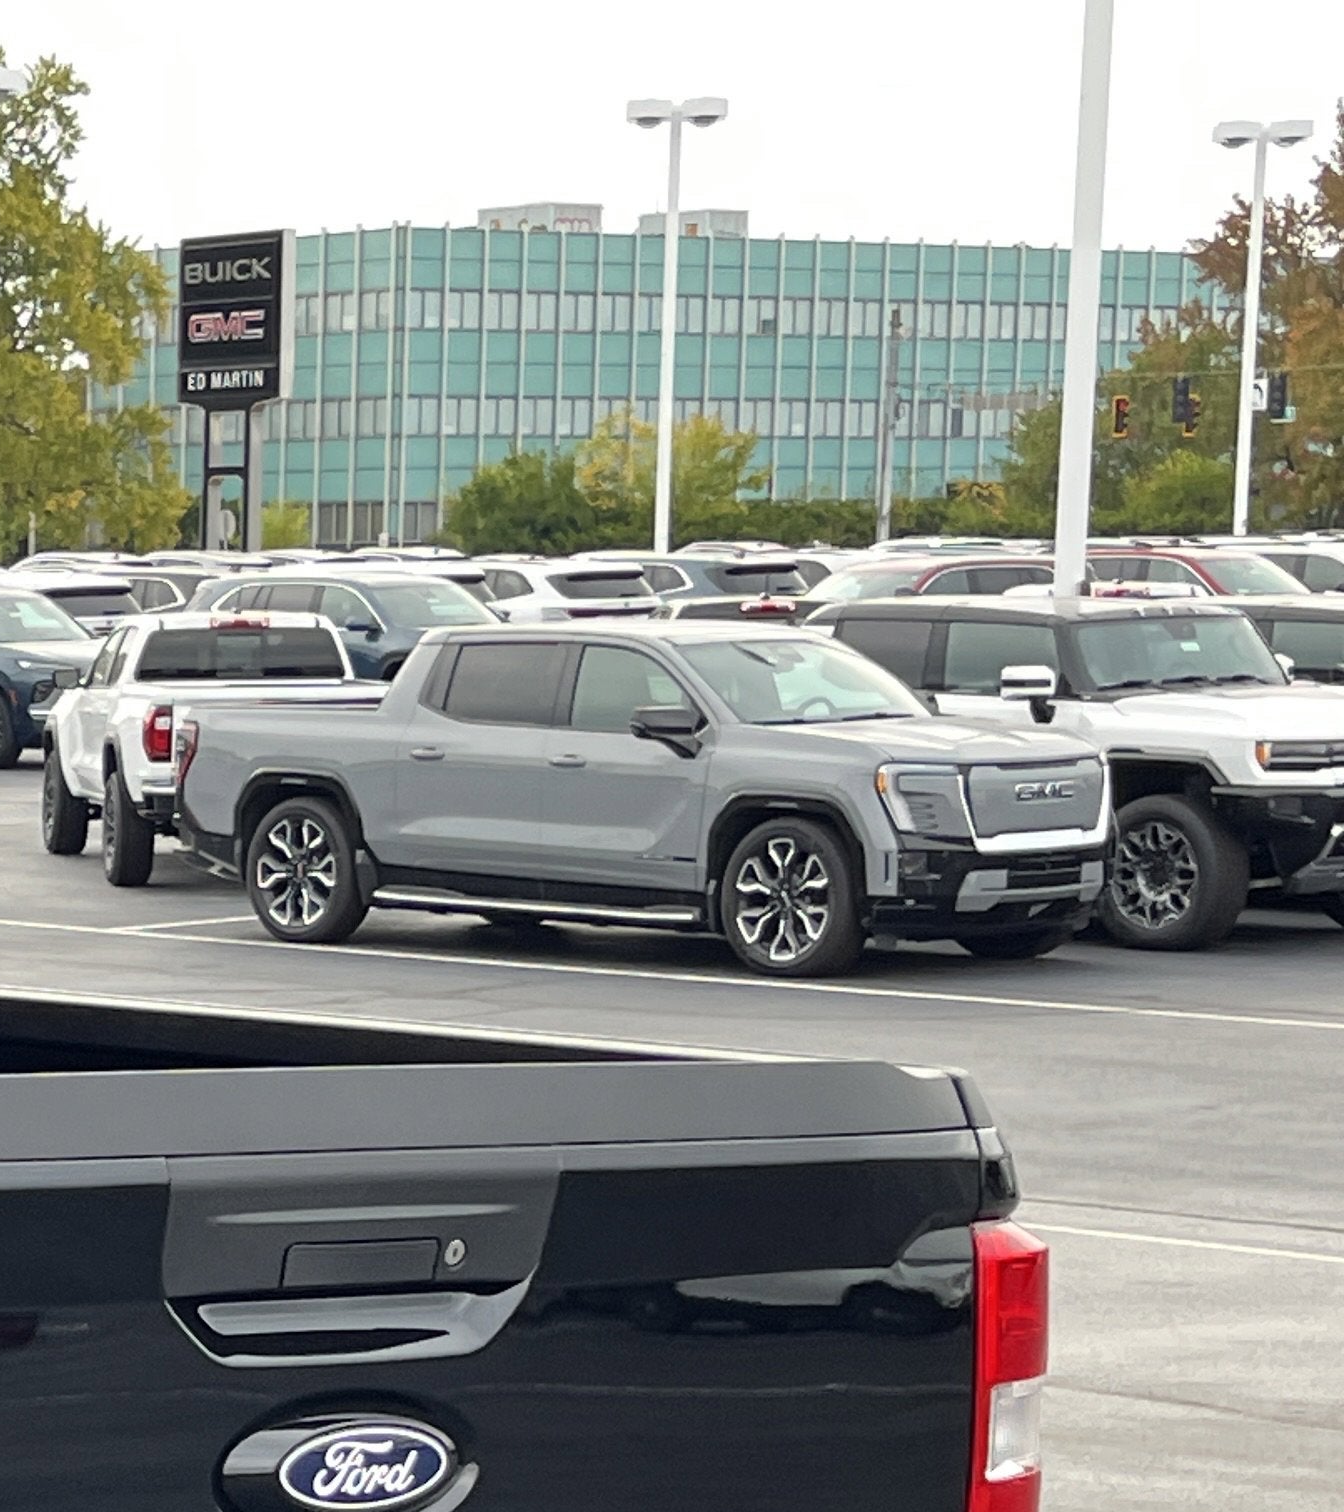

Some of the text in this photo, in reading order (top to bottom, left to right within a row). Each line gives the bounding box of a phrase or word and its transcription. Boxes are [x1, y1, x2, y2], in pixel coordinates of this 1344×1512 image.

[183, 257, 272, 284] BUICK
[188, 309, 265, 343] GMC
[187, 370, 264, 391] ED MARTIN
[1015, 780, 1075, 801] GMC
[313, 1440, 418, 1496] Ford
